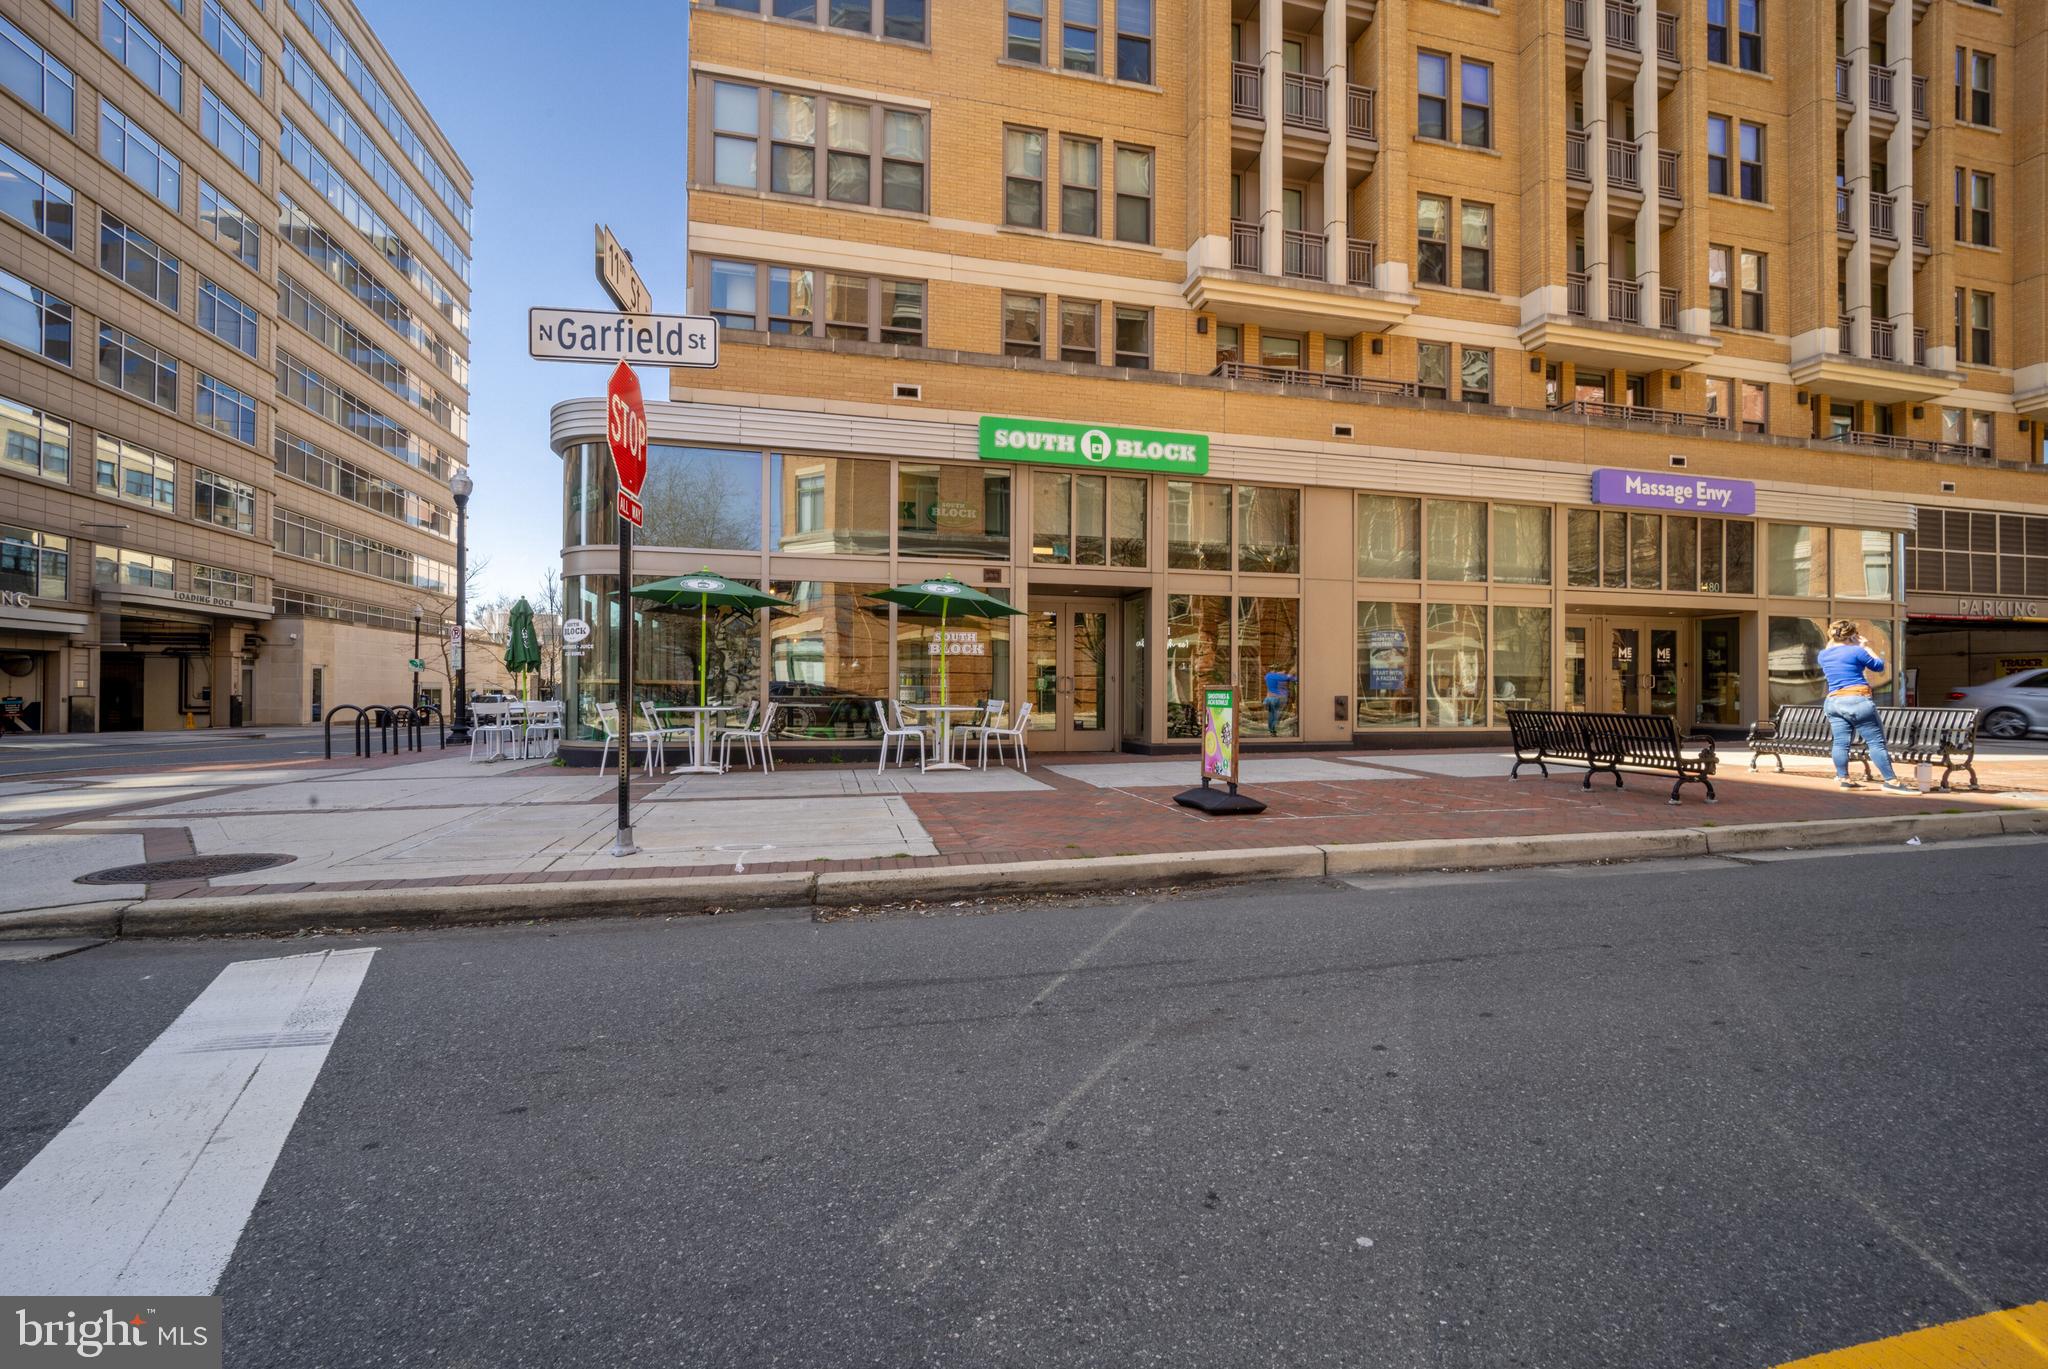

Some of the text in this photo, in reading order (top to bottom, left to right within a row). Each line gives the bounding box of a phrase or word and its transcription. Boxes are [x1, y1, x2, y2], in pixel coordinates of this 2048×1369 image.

[609, 244, 641, 312] 11th St
[539, 317, 707, 356] N Garfield St
[611, 393, 646, 462] STOP
[995, 430, 1197, 462] SOUTH BLOCK
[1625, 475, 1733, 508] Massage Envy
[619, 496, 642, 521] ALL WAY
[931, 507, 977, 519] BLOCK
[174, 592, 235, 608] LOADING DOCK
[1958, 599, 2039, 617] PARKING
[934, 631, 977, 642] SOUTH
[929, 643, 984, 655] BLOCK
[1618, 647, 1633, 659] ME
[1656, 648, 1671, 659] ME
[2000, 658, 2043, 667] TRADER
